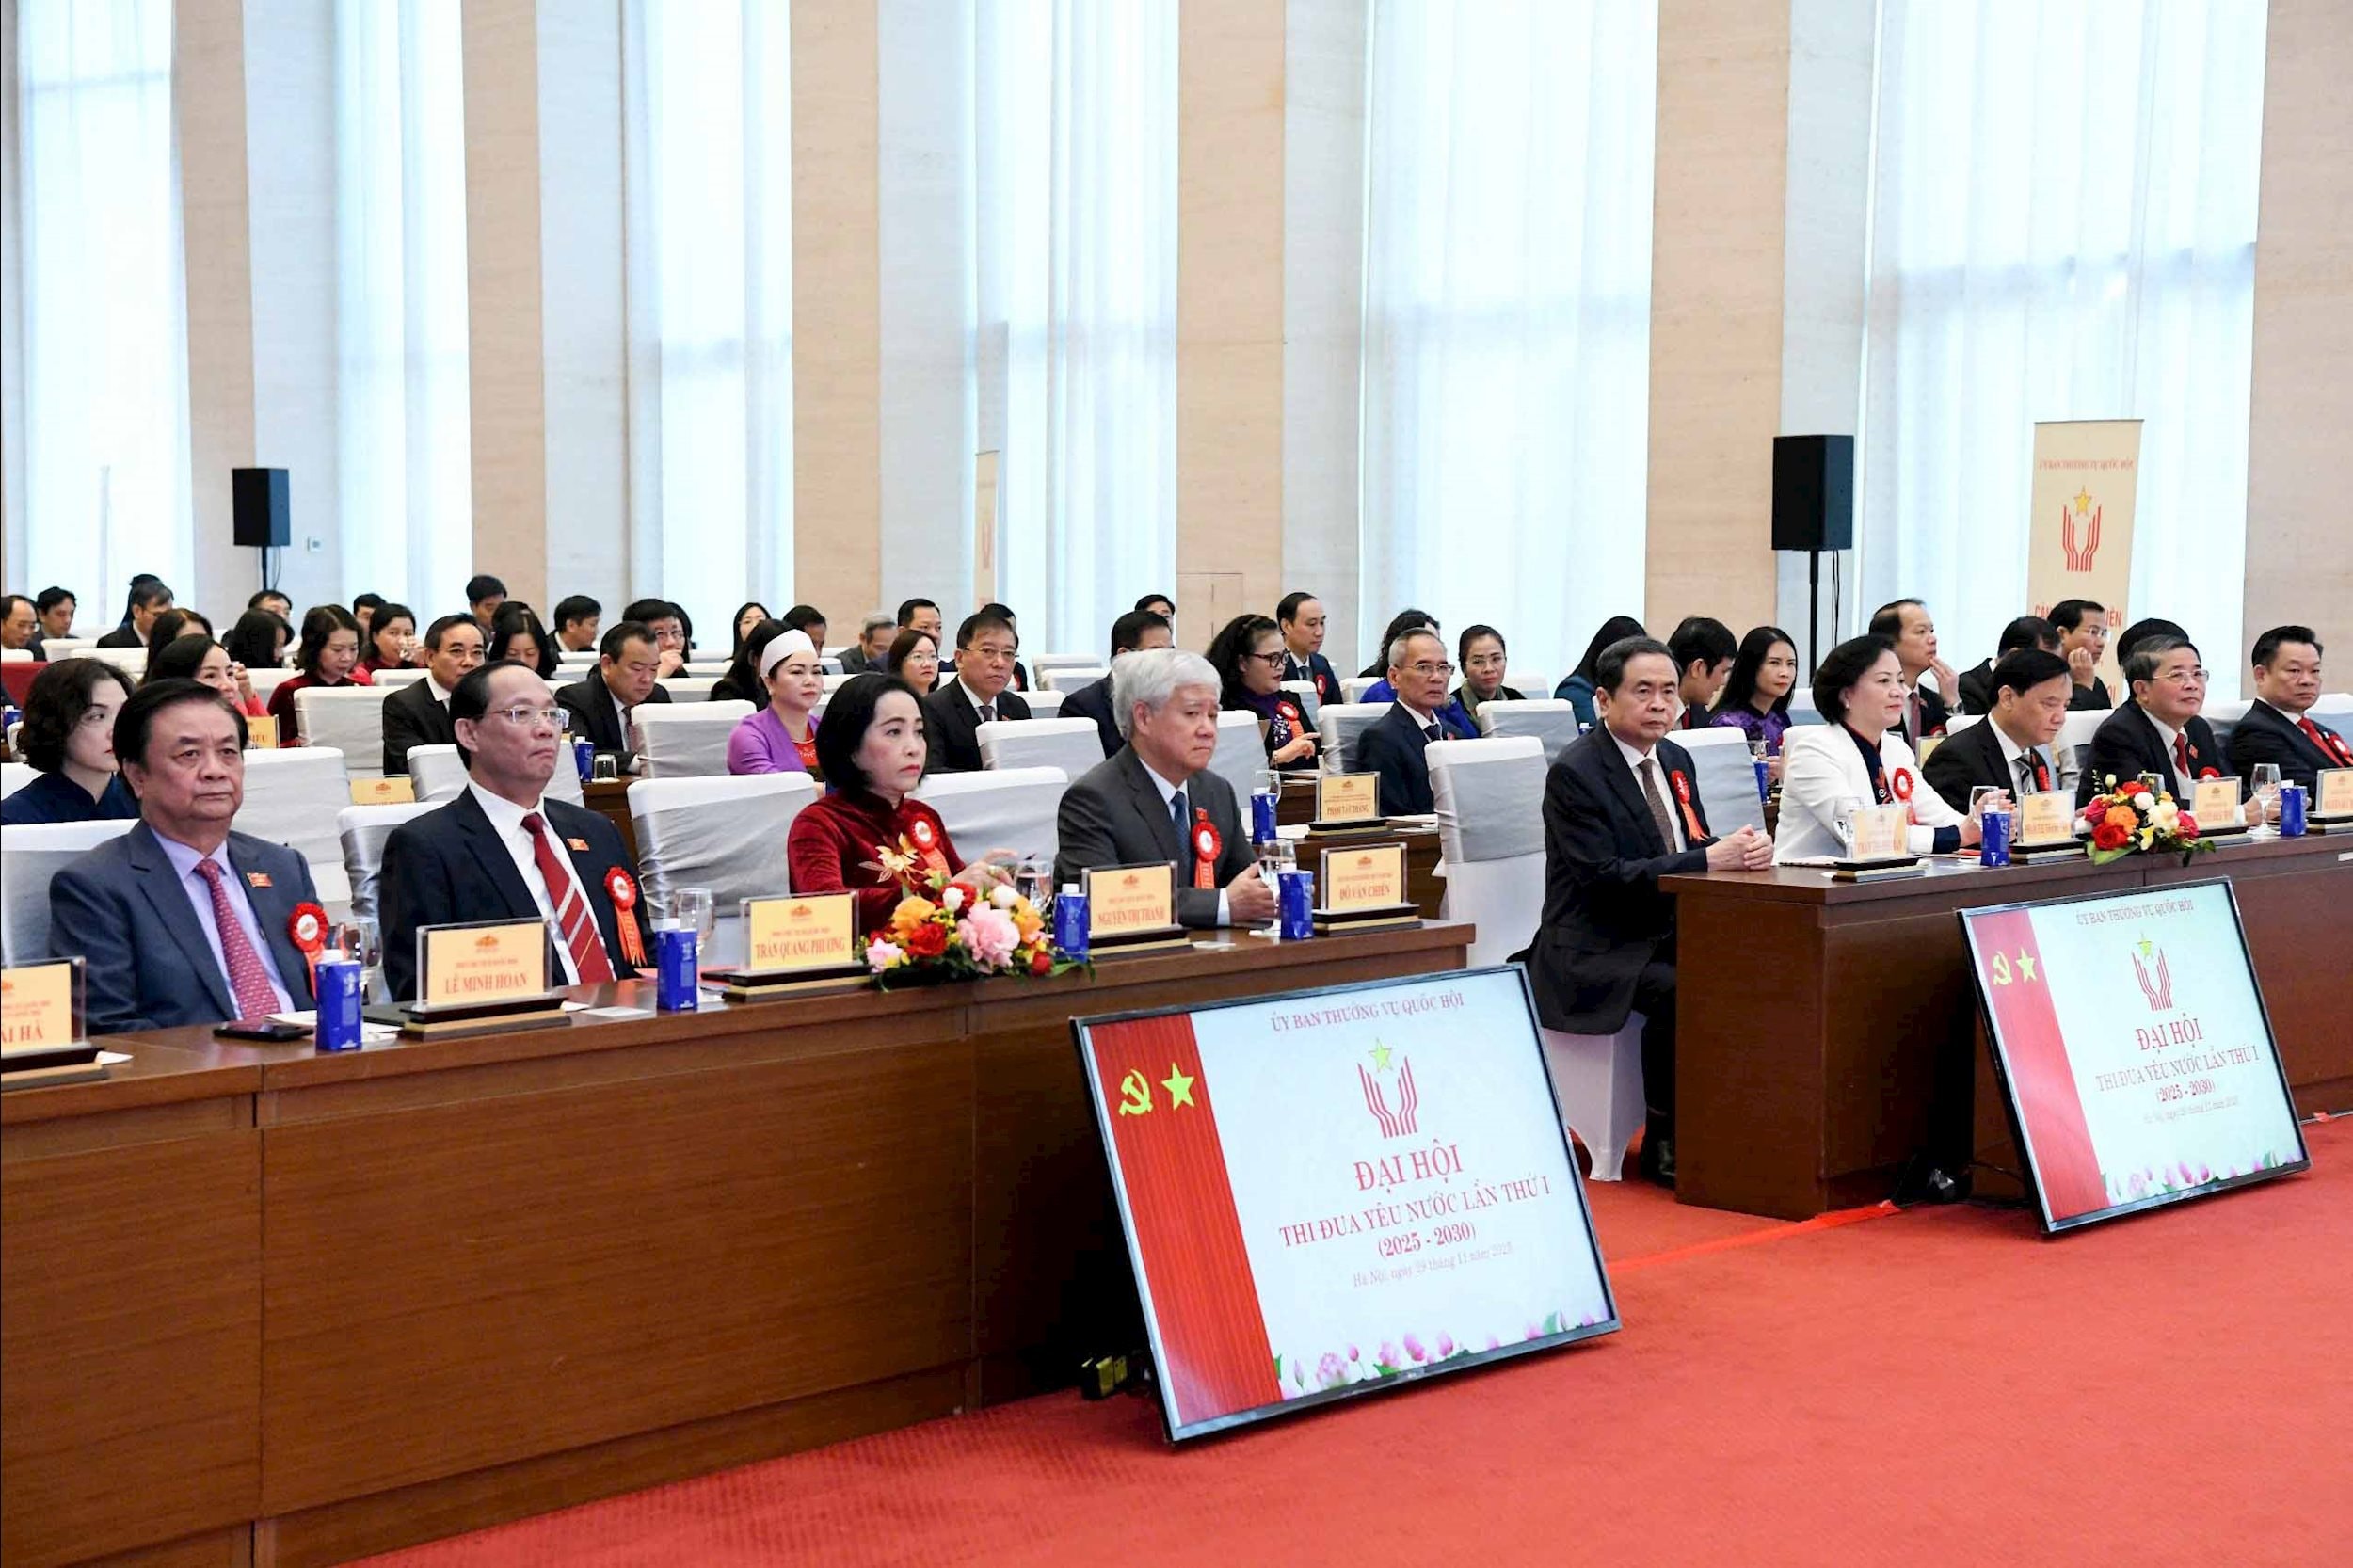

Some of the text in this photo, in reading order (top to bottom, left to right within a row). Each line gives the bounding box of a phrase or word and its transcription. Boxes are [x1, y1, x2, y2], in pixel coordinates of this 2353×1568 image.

[780, 940, 810, 961] QUANG
[463, 973, 493, 992] MINH
[495, 970, 527, 989] HOAN
[1292, 1012, 1321, 1030] BAN
[1322, 1000, 1380, 1025] THƯỜNG
[1381, 1001, 1400, 1016] VỤ
[1401, 993, 1437, 1015] QUỐC
[1440, 989, 1465, 1011] HỘI
[2135, 1012, 2203, 1055] ĐẠI HỘI
[2156, 1083, 2184, 1103] (2025
[2189, 1079, 2215, 1096] 2030)
[1353, 1139, 1464, 1194] ĐẠI HỘI
[1279, 1171, 1551, 1248] THI ĐUA YÊU NƯỚC LẦN THỨ I
[1378, 1231, 1423, 1259] (2025
[1433, 1221, 1478, 1247] 2030)
